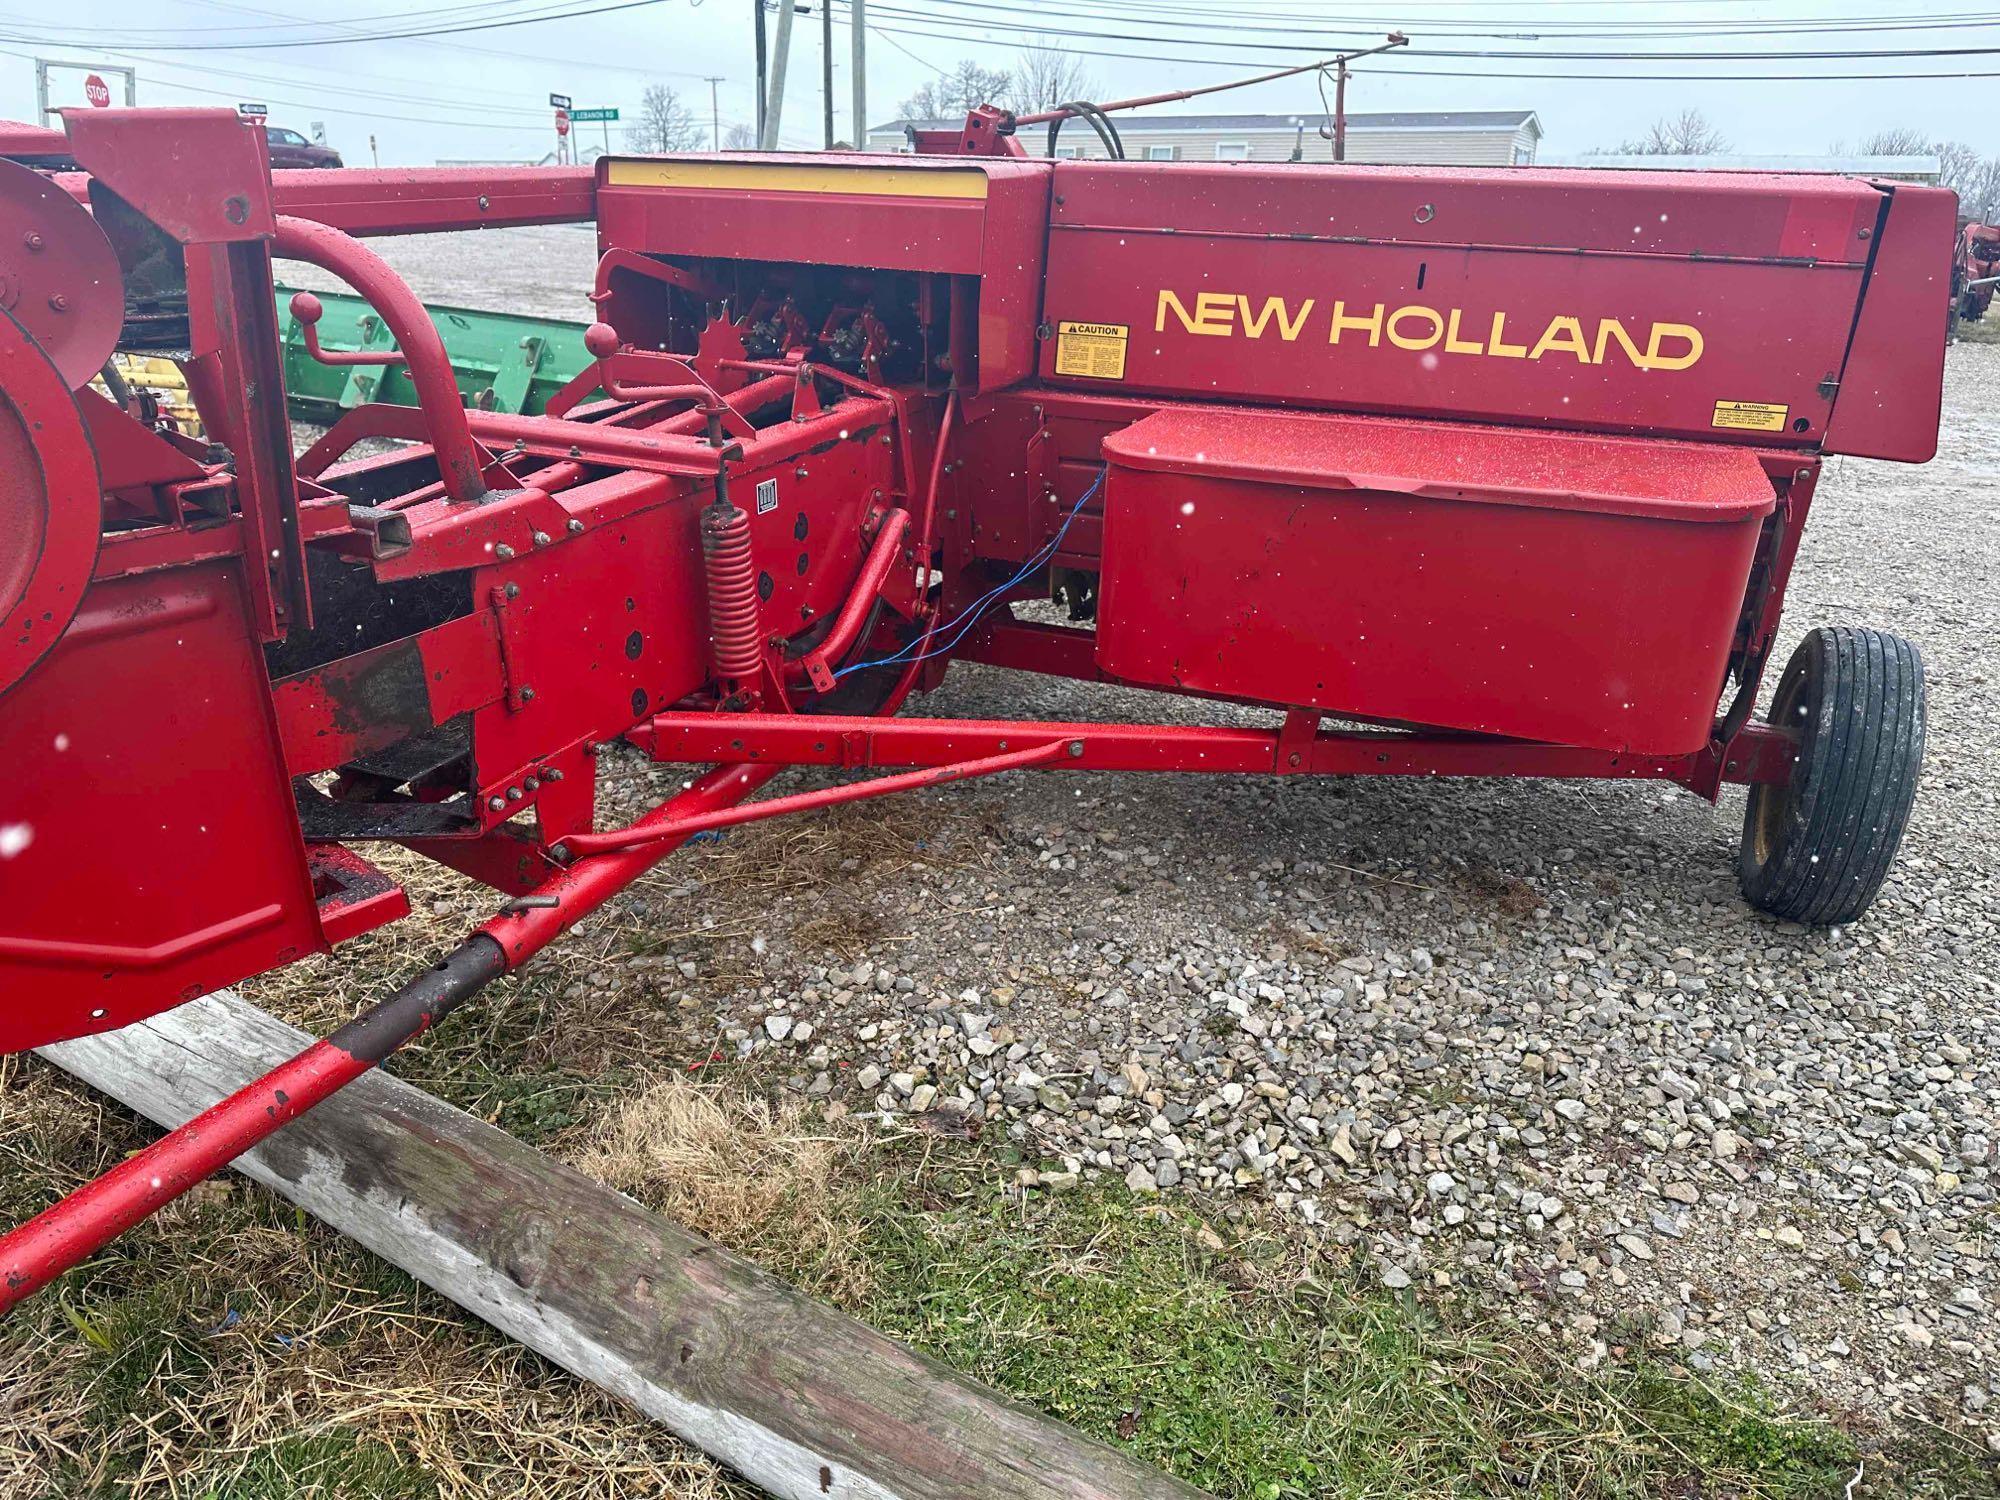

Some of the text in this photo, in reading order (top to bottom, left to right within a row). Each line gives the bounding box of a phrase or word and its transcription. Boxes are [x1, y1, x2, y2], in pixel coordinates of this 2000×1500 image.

[87, 84, 107, 102] STOP
[576, 111, 604, 119] LEBANON
[1078, 325, 1119, 335] CAUTION
[1155, 289, 1704, 370] NEW HOLLAND
